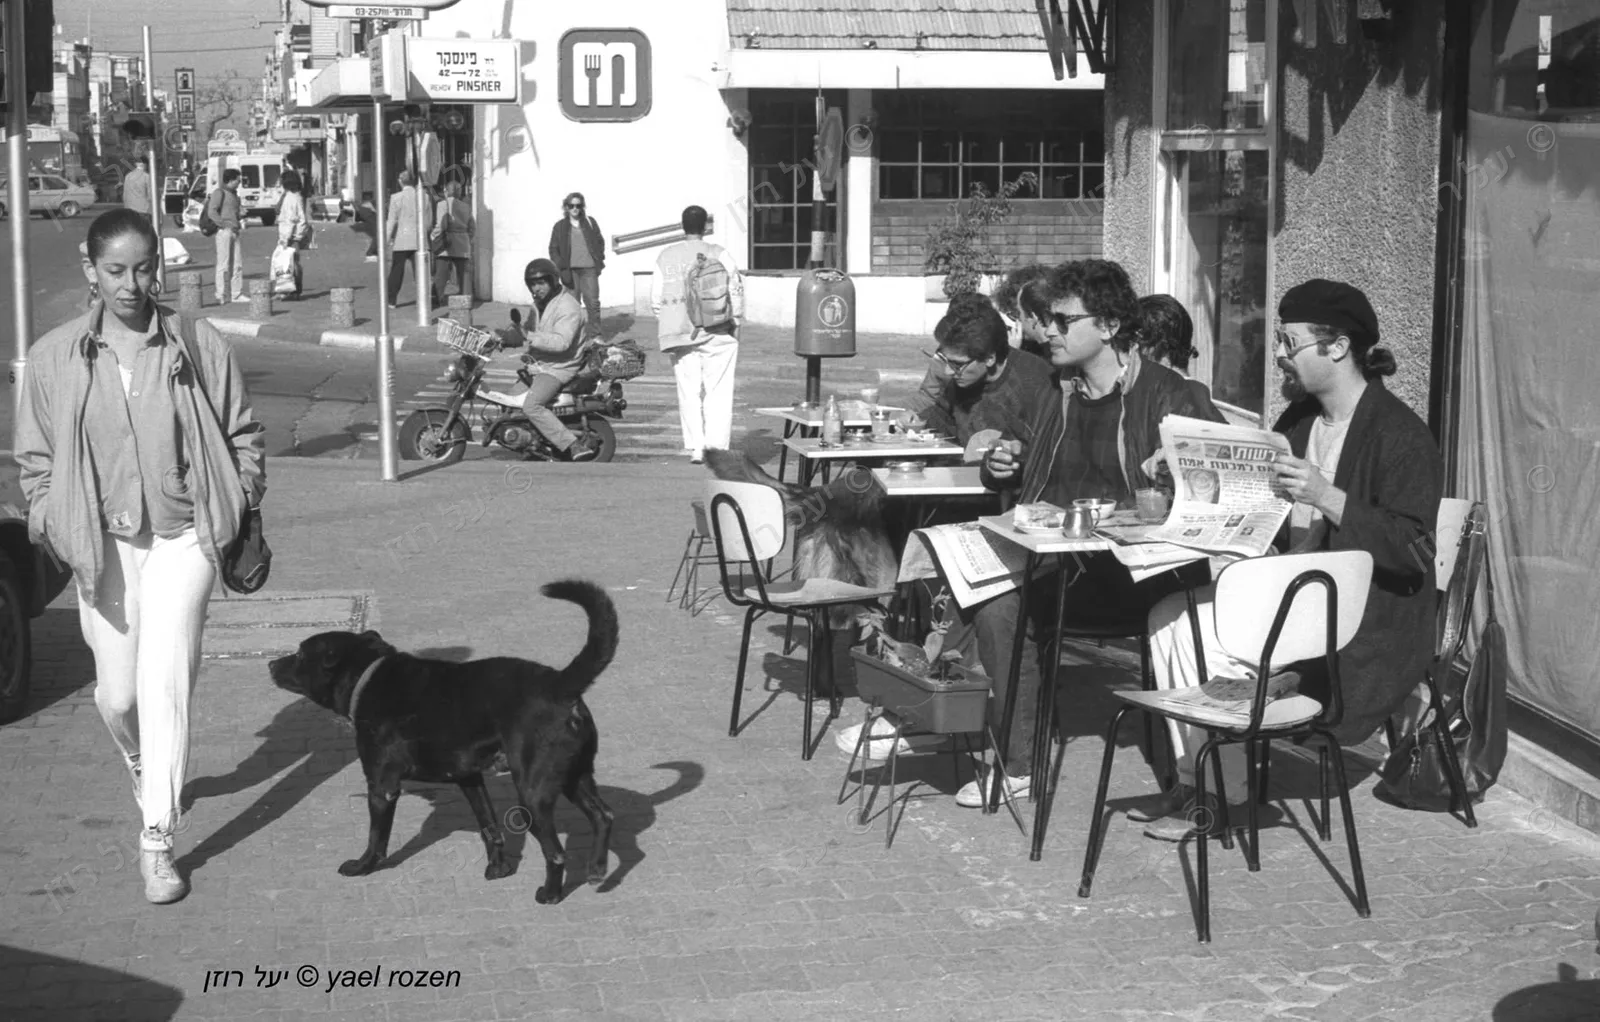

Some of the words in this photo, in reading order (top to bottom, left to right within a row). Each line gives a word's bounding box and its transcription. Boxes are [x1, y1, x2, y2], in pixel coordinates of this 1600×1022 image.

[436, 52, 478, 67] פינסקר
[438, 69, 451, 77] 42
[468, 69, 481, 77] 72
[456, 80, 502, 92] PINSKER
